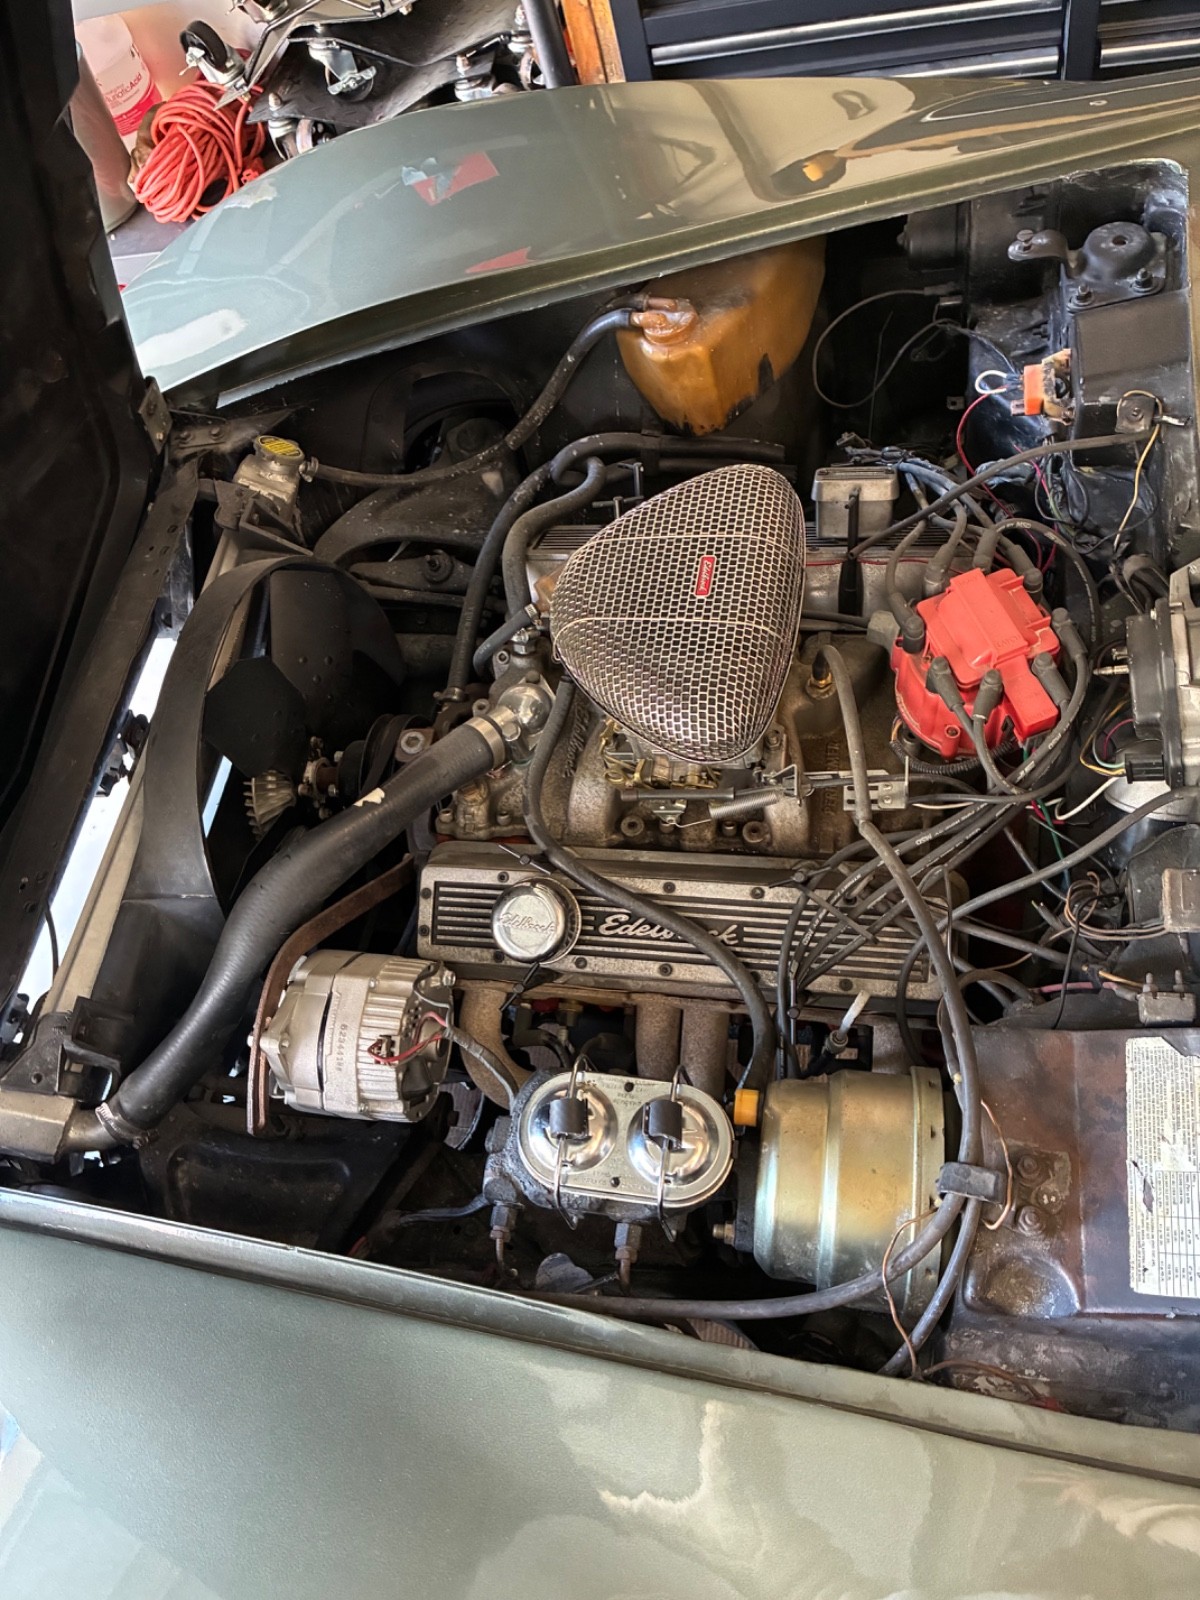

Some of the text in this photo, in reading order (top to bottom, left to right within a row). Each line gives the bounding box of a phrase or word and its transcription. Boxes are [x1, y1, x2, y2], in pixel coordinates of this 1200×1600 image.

[915, 833, 932, 846] MSD
[499, 911, 557, 934] Edelbrock
[801, 928, 814, 946] MSD
